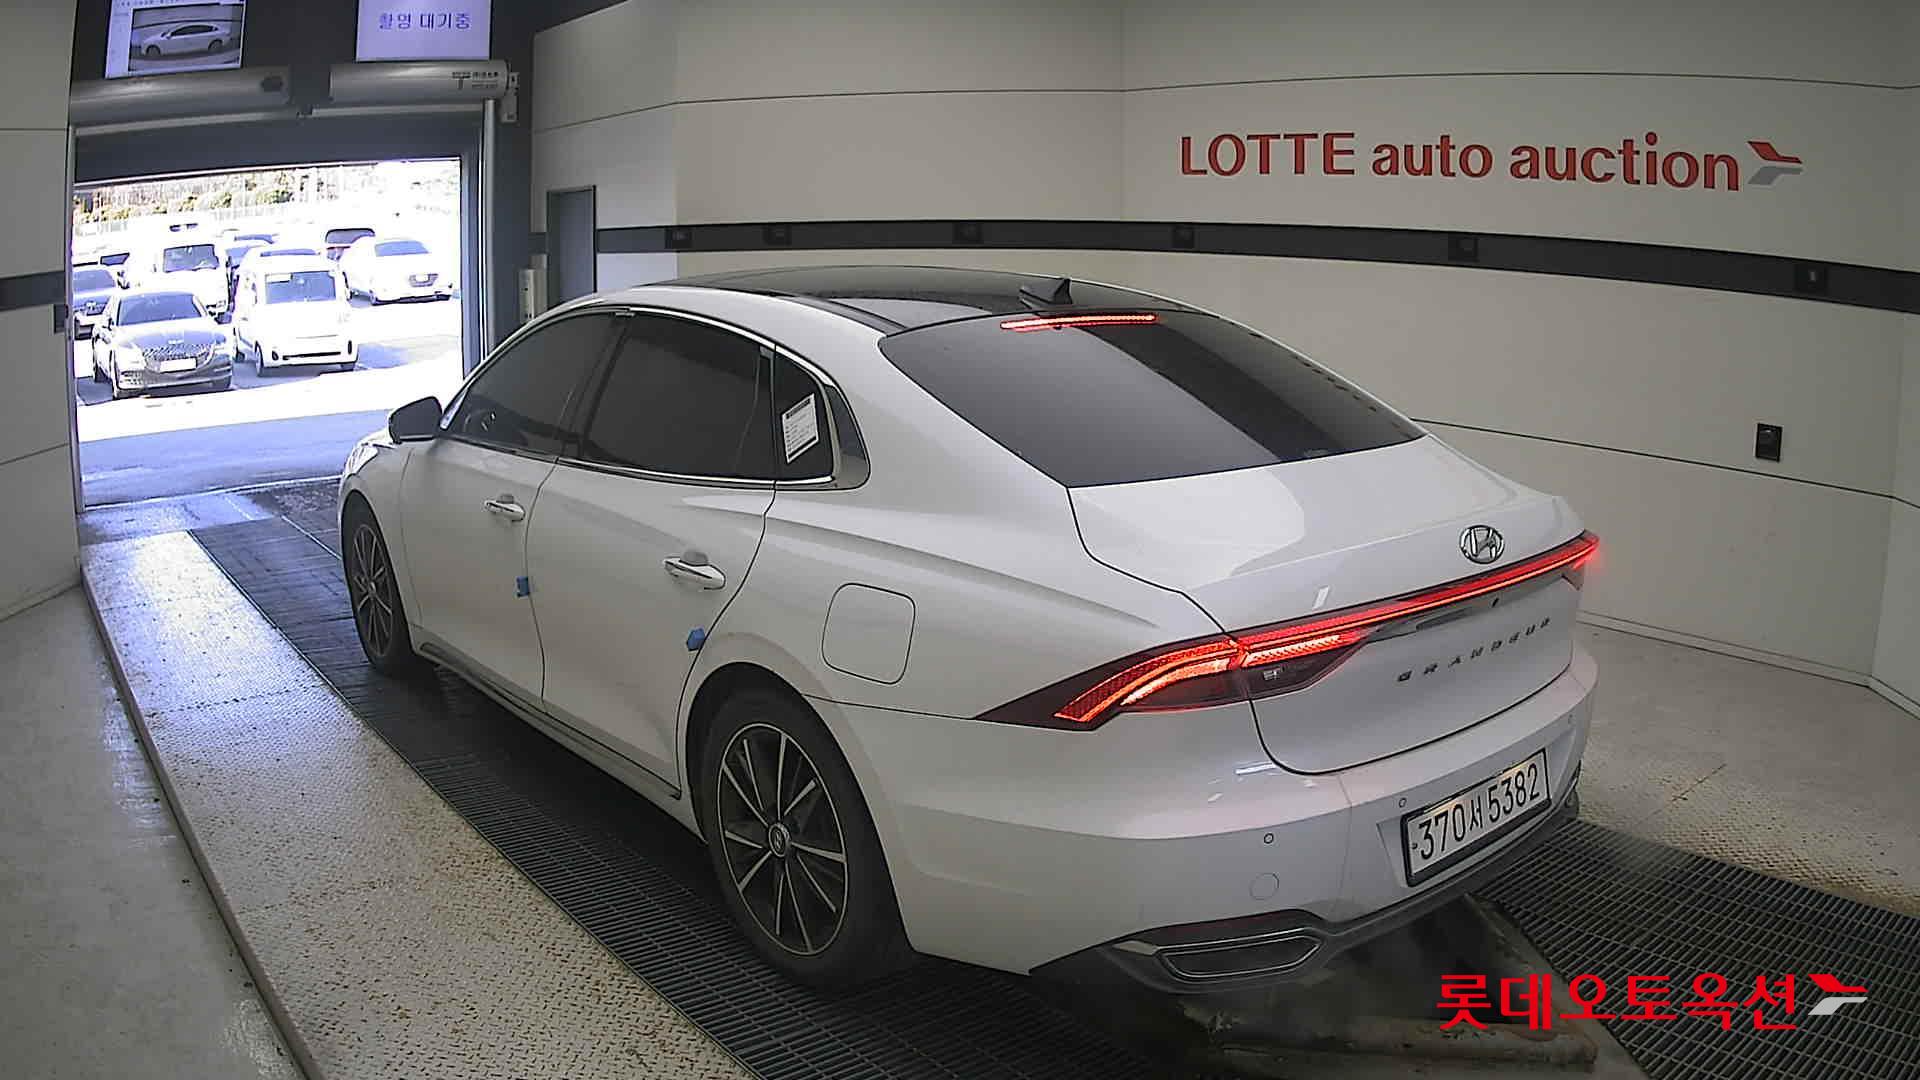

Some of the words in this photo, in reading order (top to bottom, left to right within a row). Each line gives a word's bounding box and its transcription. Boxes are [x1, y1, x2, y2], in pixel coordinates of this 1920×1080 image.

[419, 12, 472, 30] 대기중
[1181, 132, 1356, 177] LOTTE
[1371, 134, 1494, 178] auto
[1509, 131, 1740, 191] auction
[1397, 616, 1551, 683] GRANDEUR
